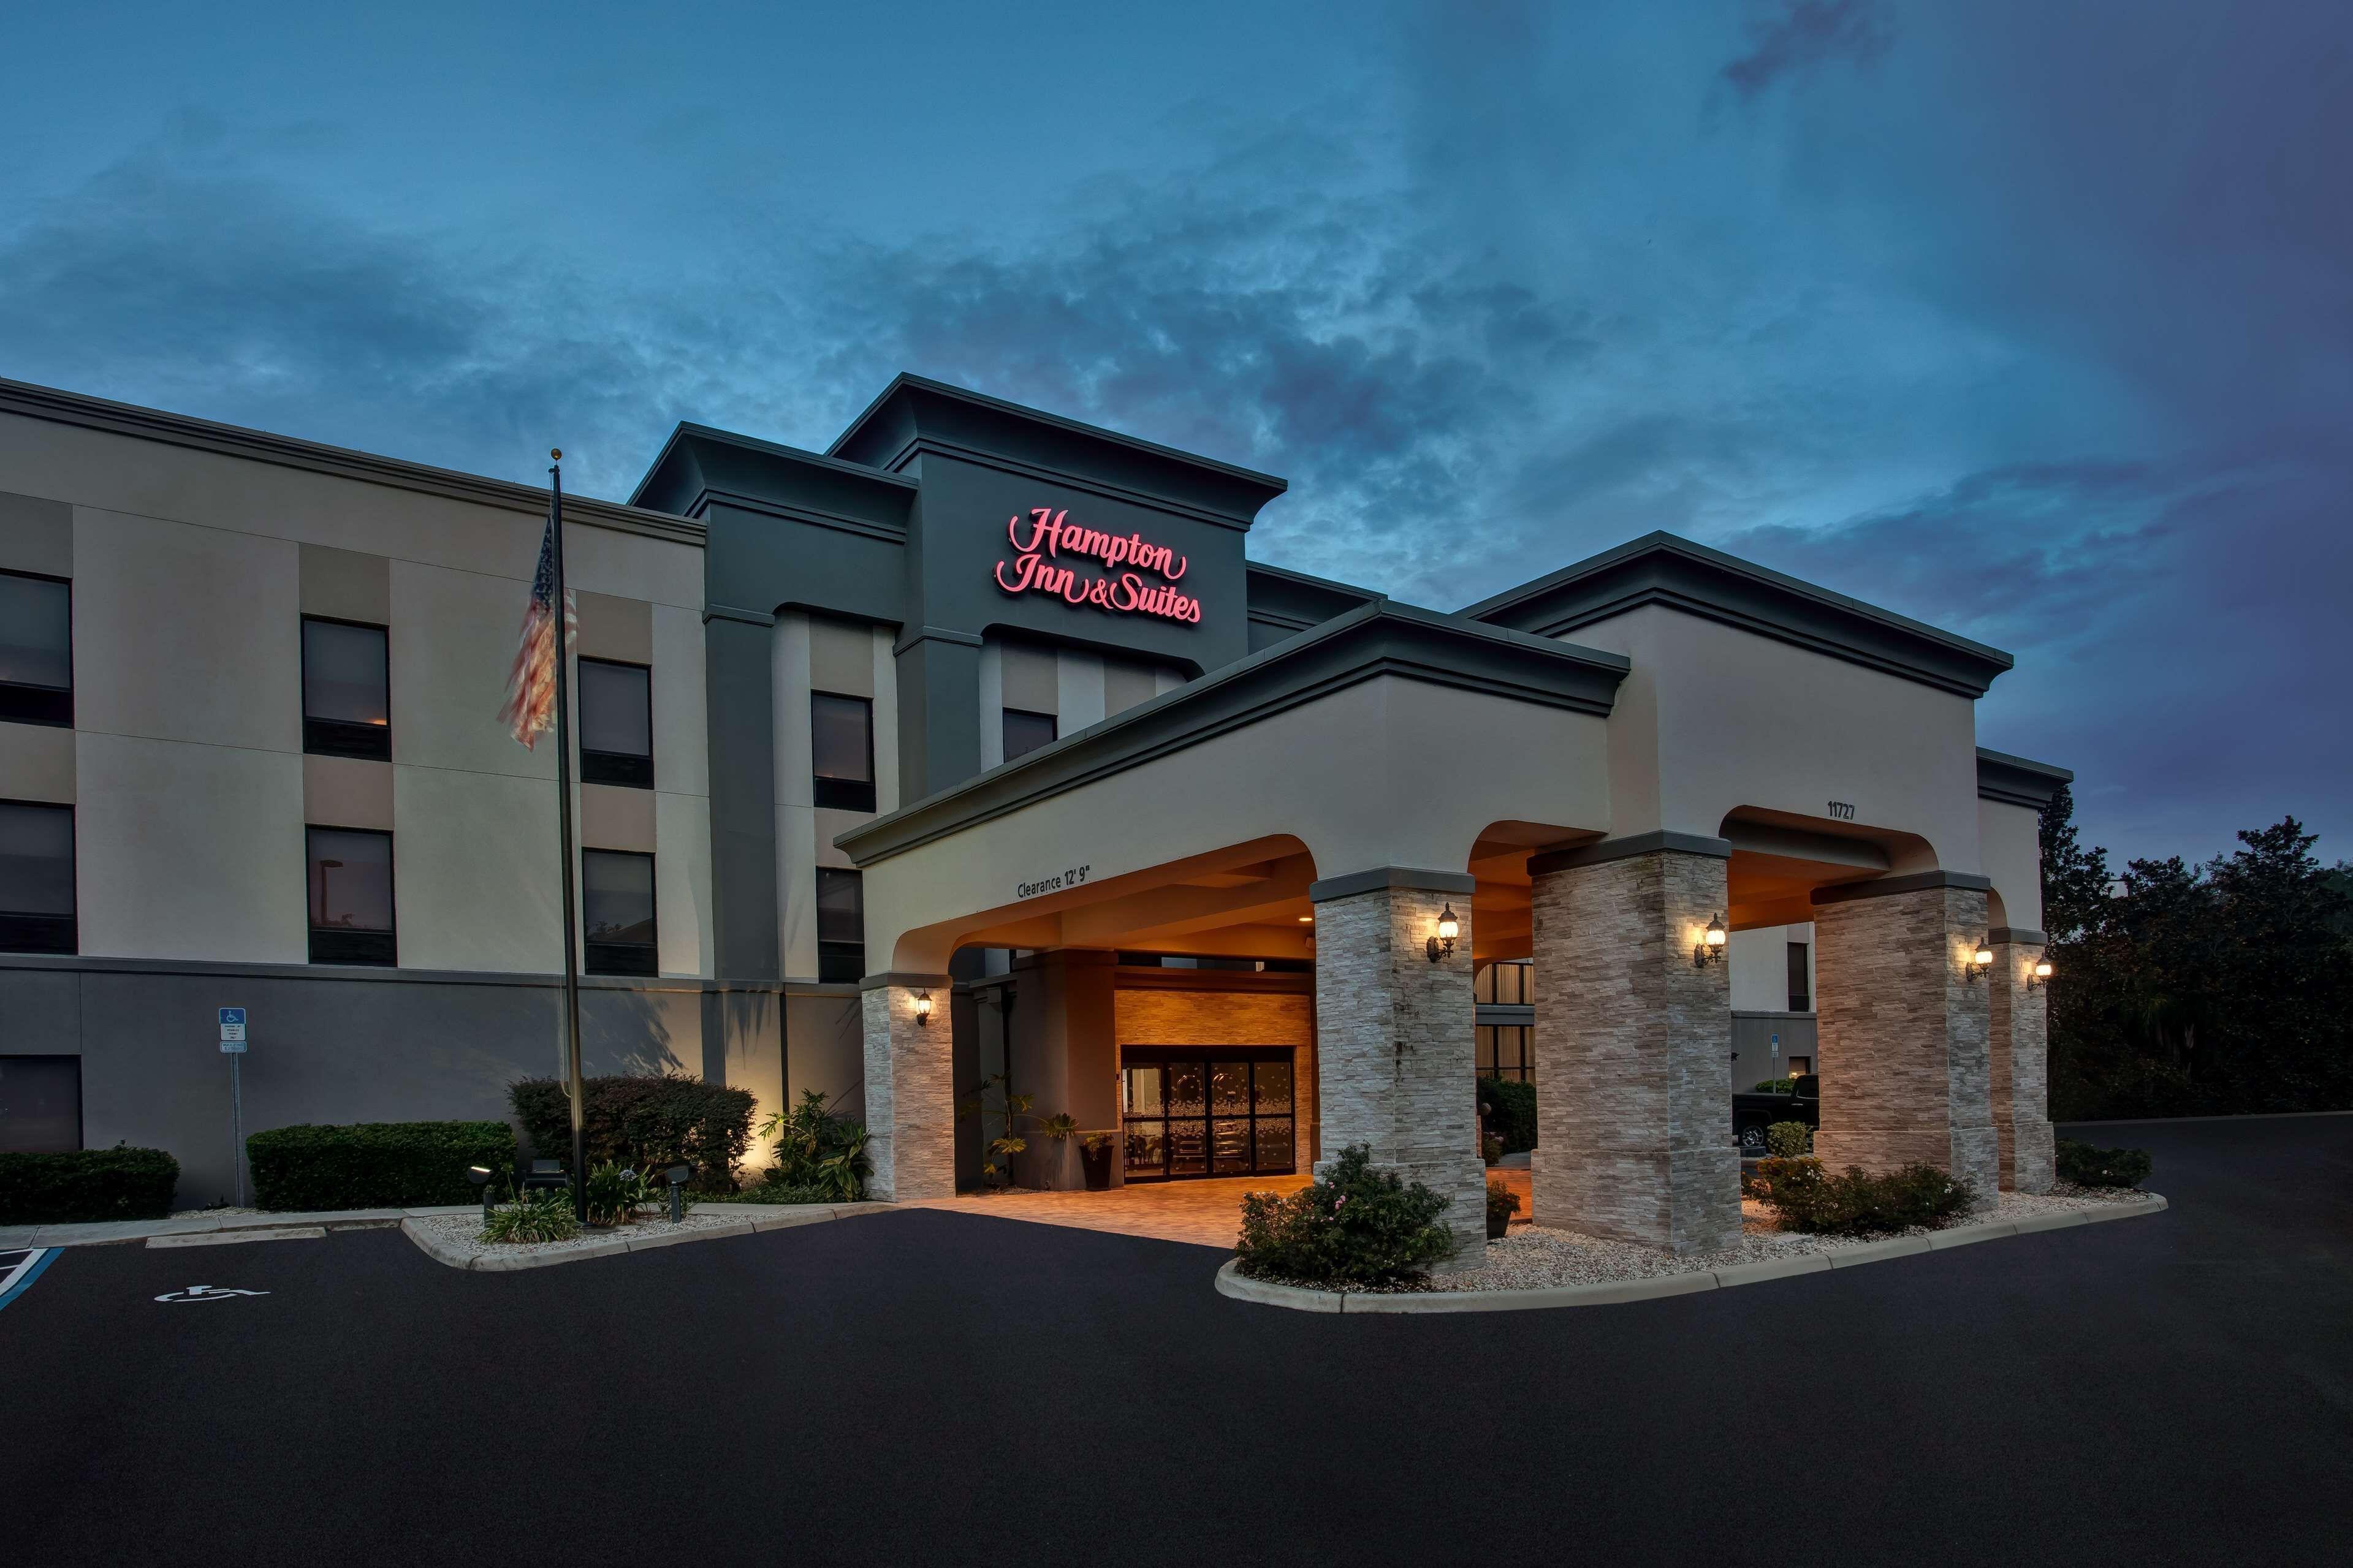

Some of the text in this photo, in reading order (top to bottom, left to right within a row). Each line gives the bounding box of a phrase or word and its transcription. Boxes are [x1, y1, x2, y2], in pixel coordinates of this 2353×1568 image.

[1009, 508, 1187, 580] Hampton
[996, 554, 1089, 603] Inn
[1109, 573, 1201, 623] Suites
[1828, 800, 1855, 820] 11727
[1017, 876, 1061, 898] Clearance
[1065, 869, 1076, 885] 12'
